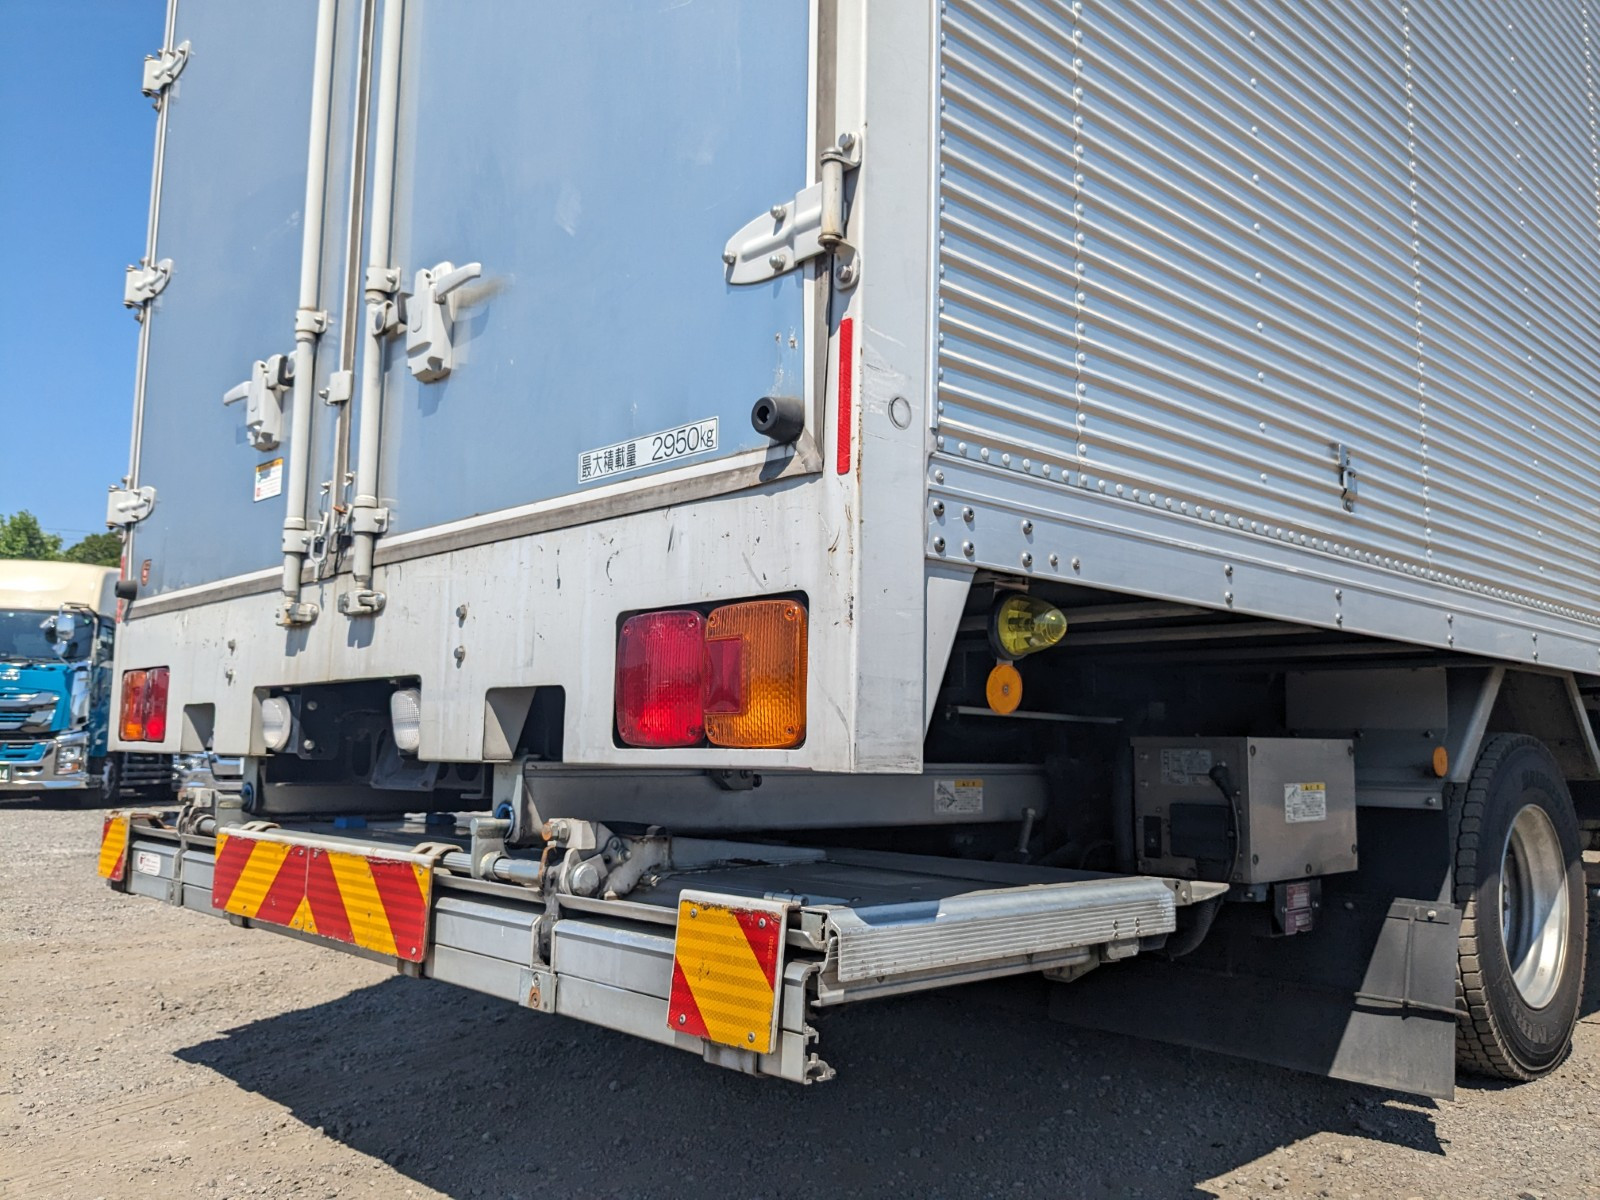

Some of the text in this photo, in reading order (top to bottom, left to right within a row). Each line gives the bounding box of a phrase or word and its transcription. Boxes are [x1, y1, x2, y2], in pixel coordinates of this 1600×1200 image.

[581, 425, 714, 478] 最大積載量 2950kg
